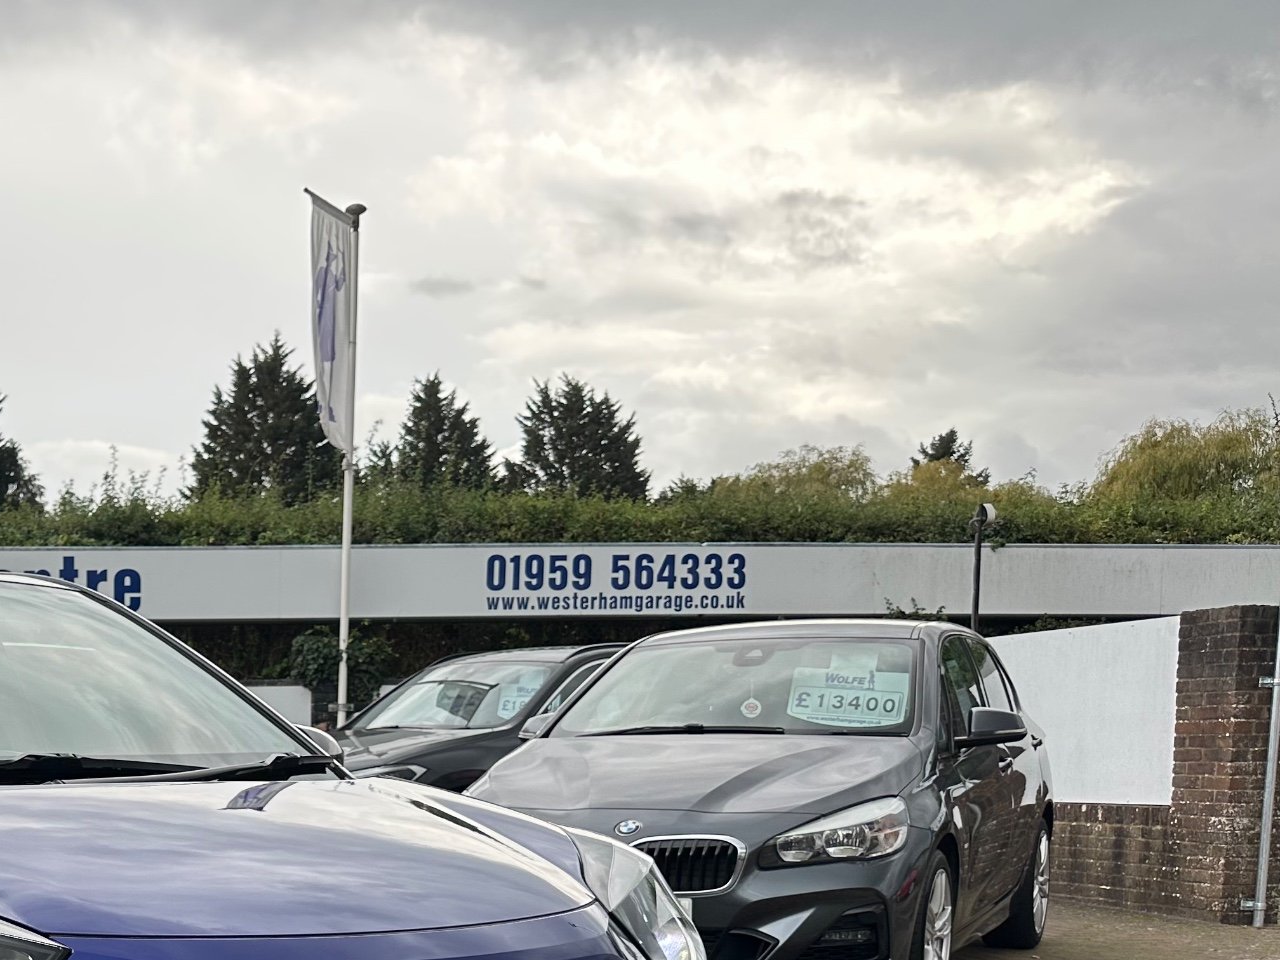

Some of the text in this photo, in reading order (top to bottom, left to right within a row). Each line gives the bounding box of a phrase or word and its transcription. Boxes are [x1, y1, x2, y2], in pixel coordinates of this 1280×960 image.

[486, 553, 746, 591] 01959 564333
[486, 592, 746, 612] www.westerhamgarage.co.uk
[825, 673, 867, 685] WOLFE
[795, 692, 896, 713] £13400
